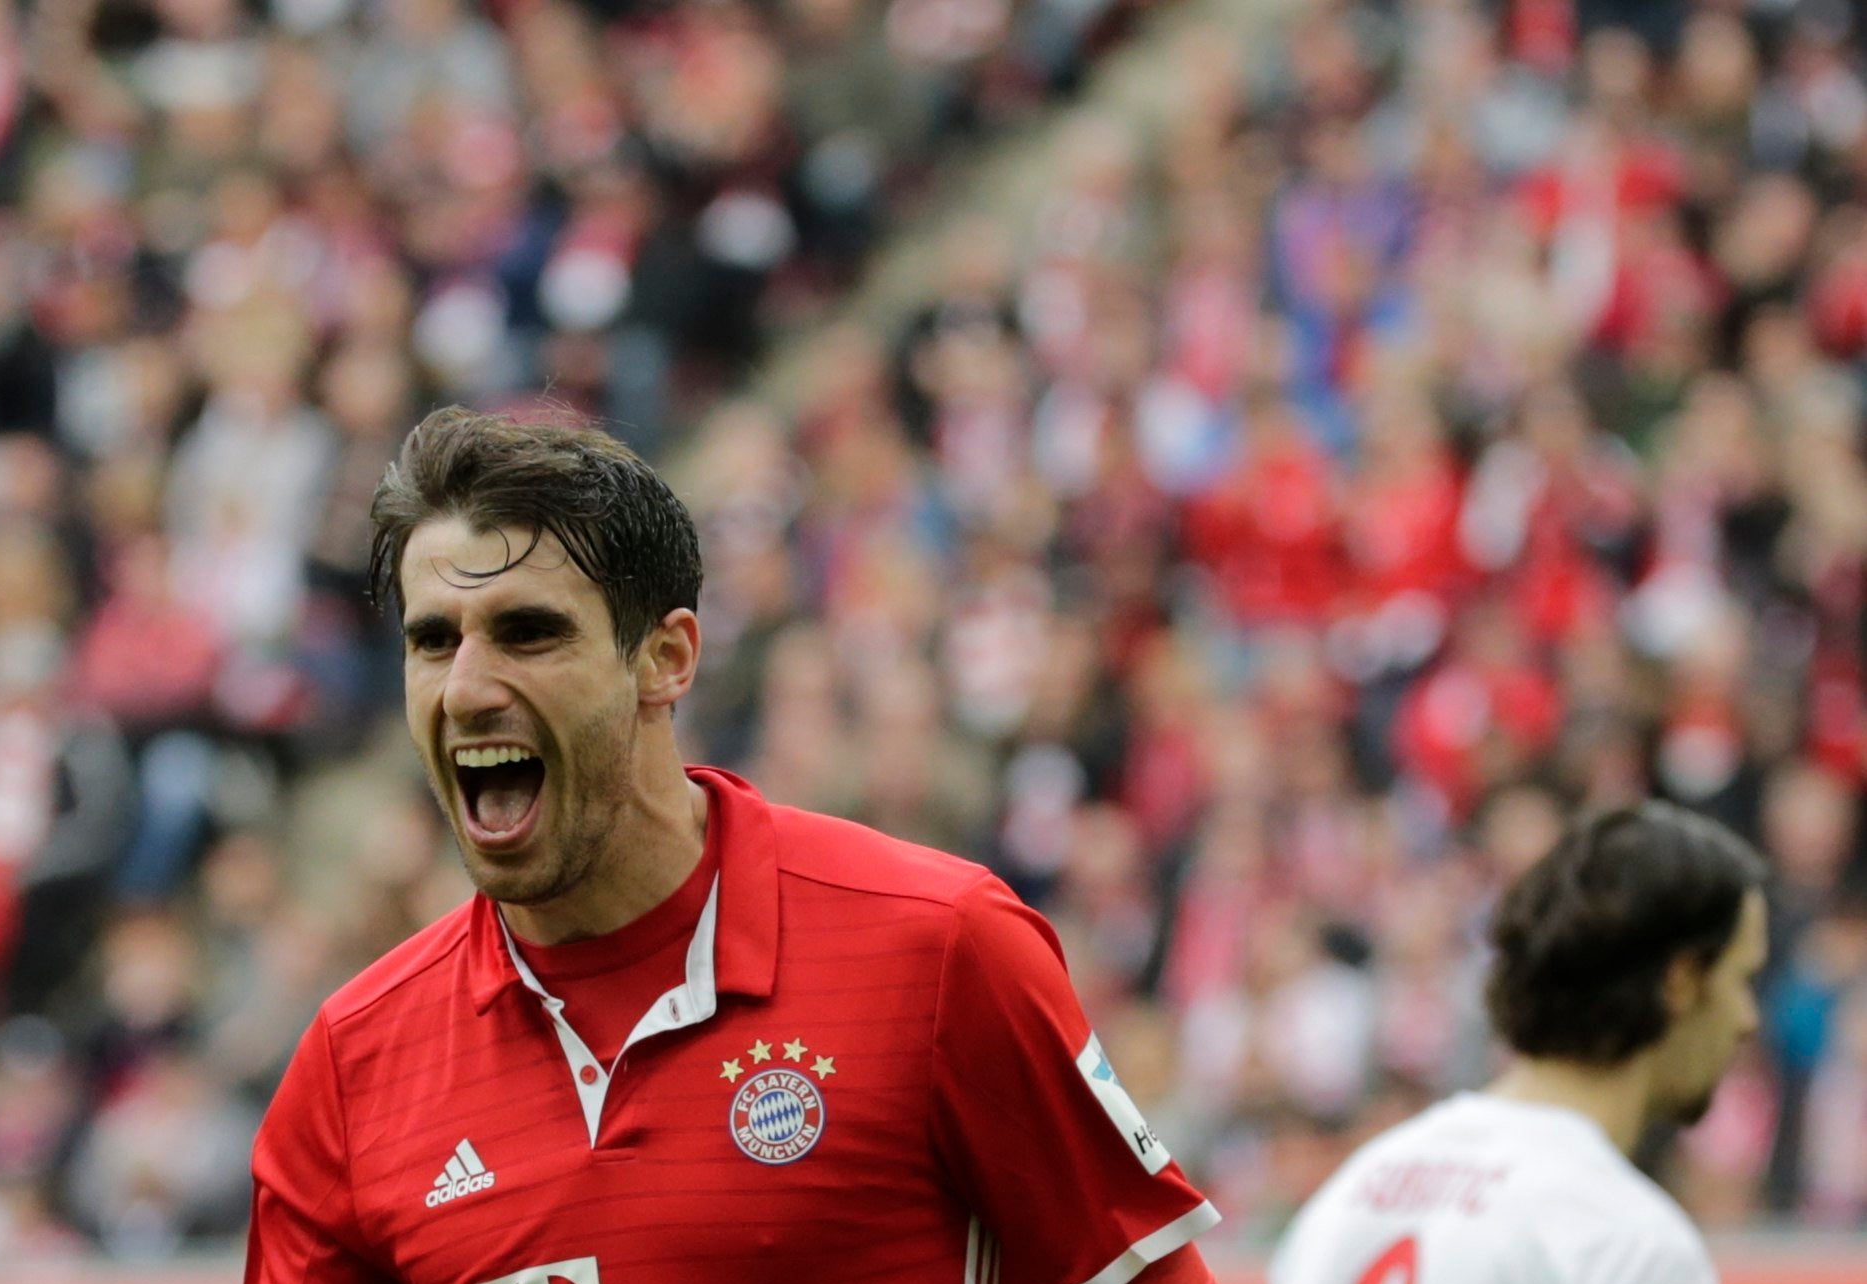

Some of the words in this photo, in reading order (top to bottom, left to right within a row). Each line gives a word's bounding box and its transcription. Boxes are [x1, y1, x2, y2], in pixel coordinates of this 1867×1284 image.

[736, 1090, 756, 1112] FC
[754, 1074, 818, 1110] BAYERN
[425, 1171, 496, 1209] adidas
